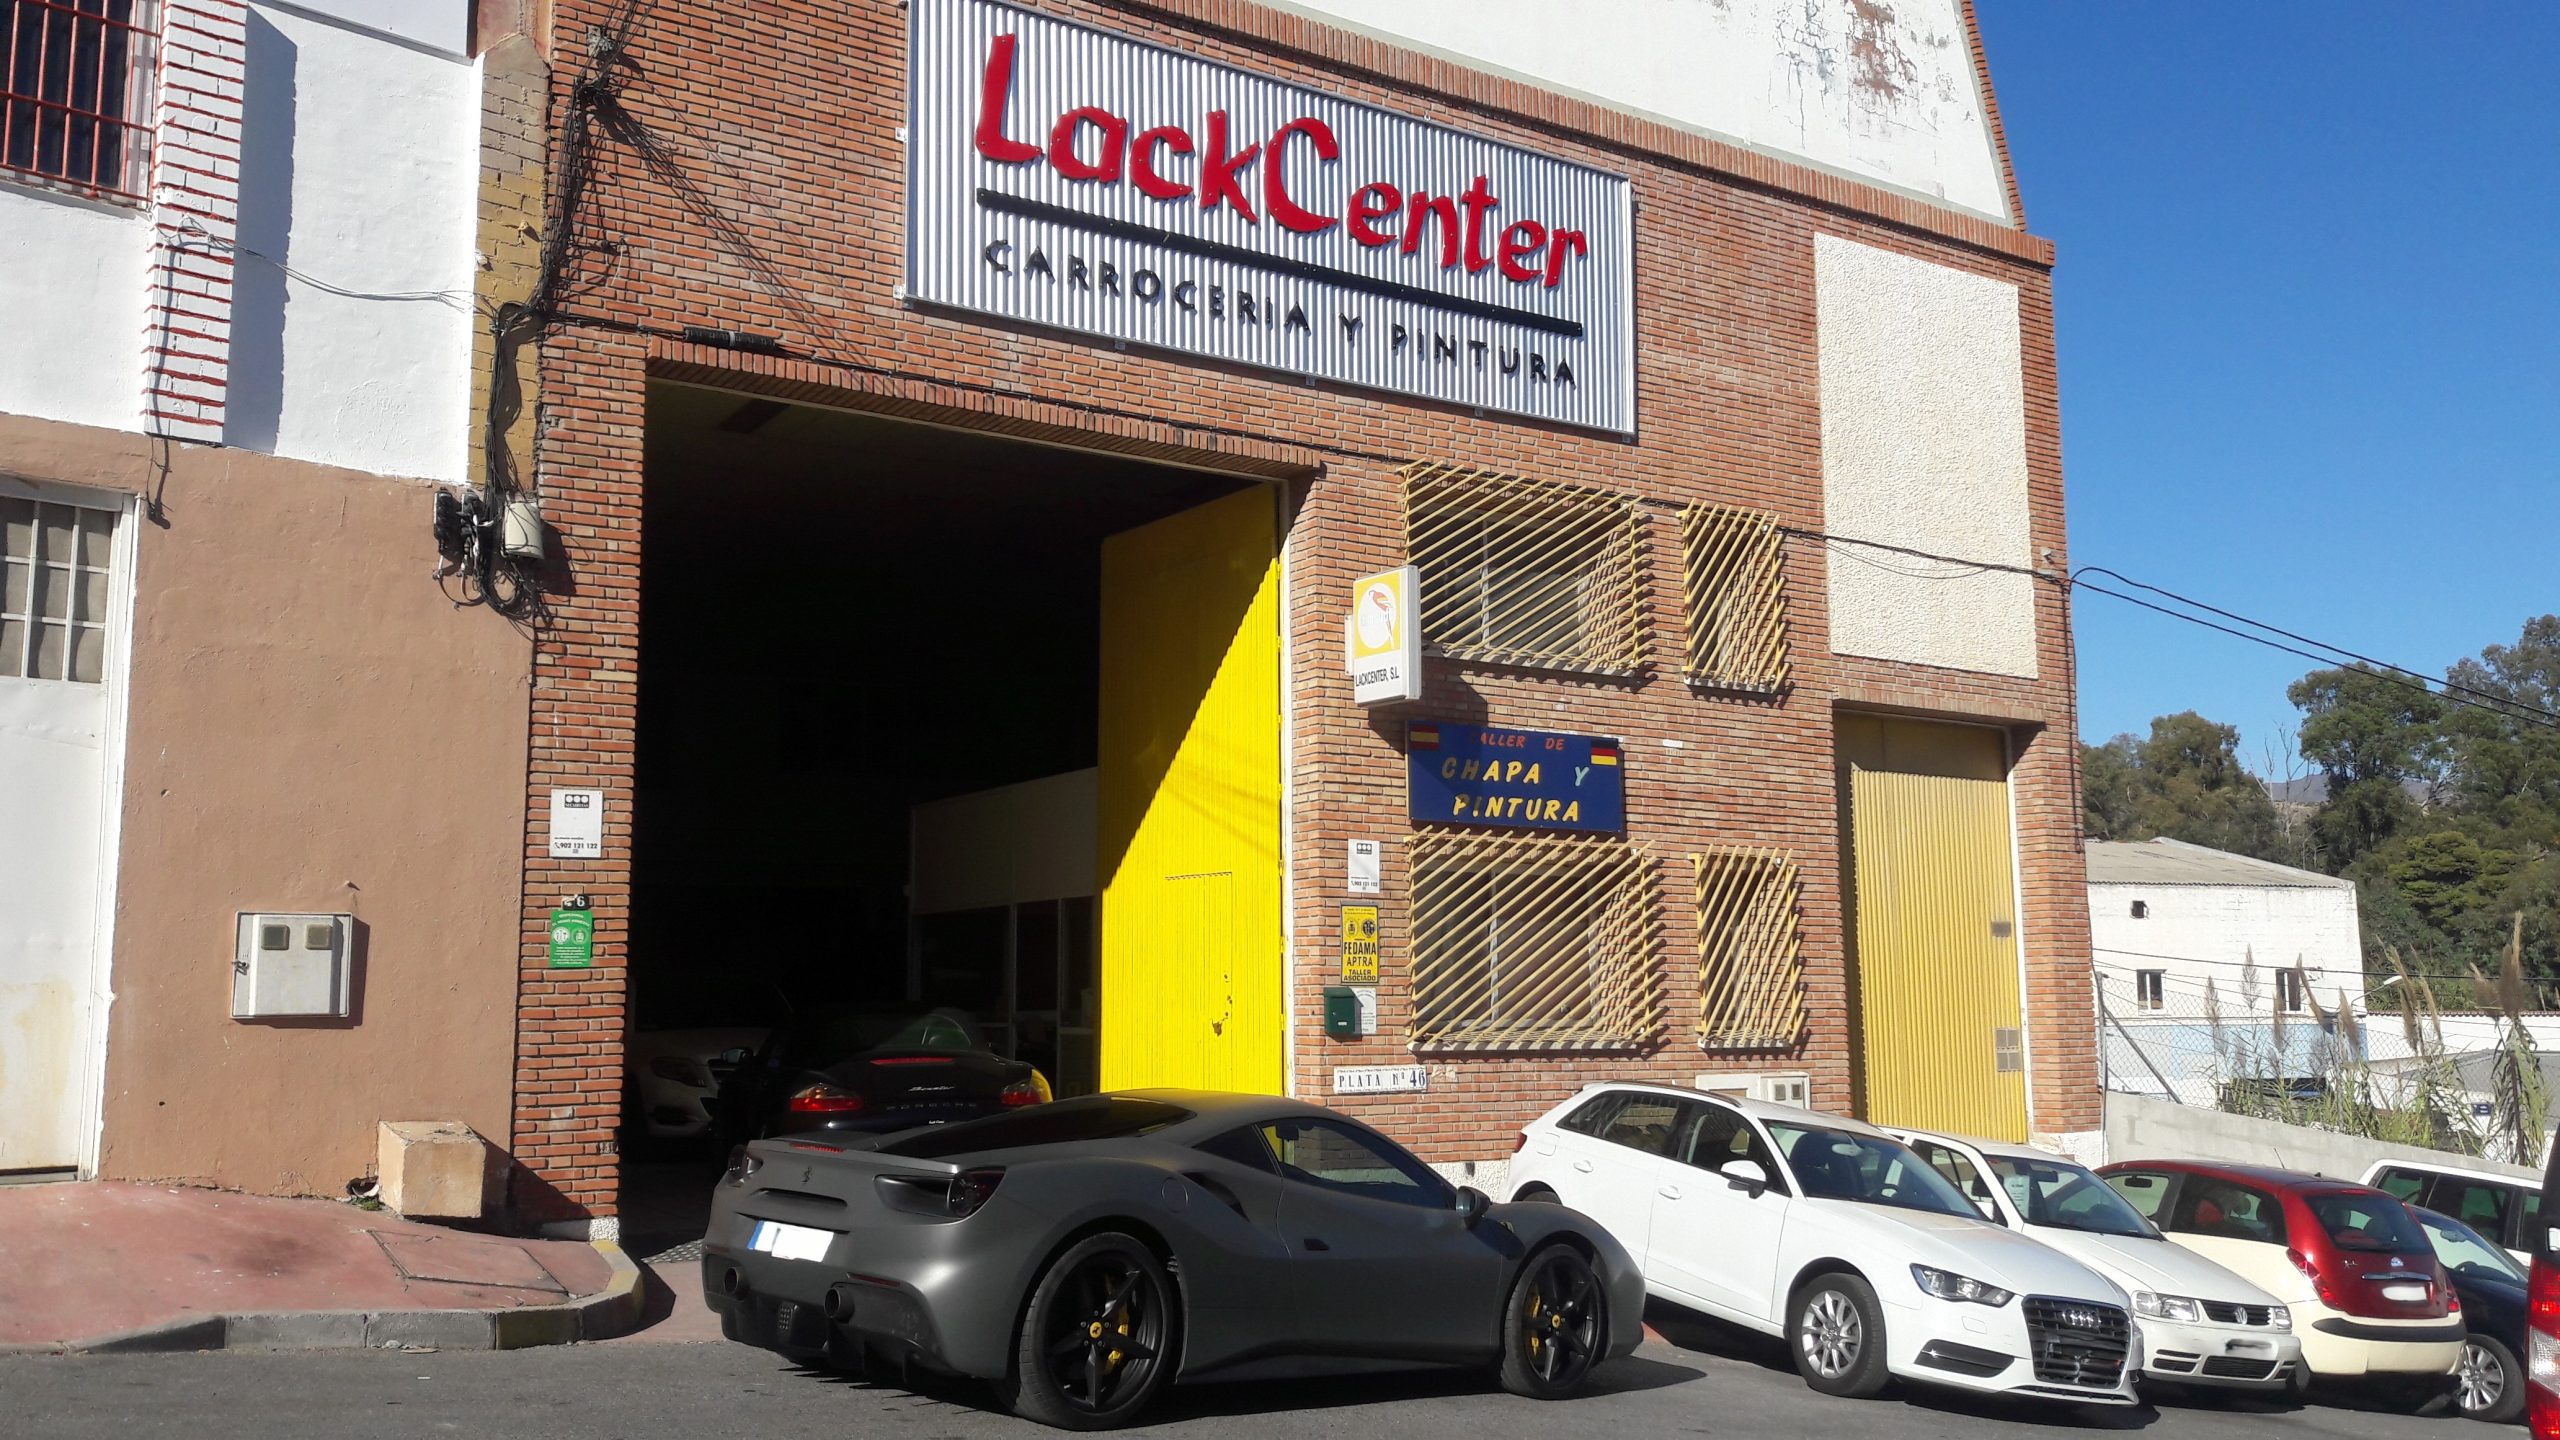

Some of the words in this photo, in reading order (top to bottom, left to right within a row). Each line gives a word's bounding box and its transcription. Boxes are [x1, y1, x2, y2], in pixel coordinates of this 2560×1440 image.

[976, 32, 1588, 288] LackCenter
[985, 238, 1312, 335] CARROCERIA
[1338, 311, 1363, 342] Y
[1391, 322, 1577, 388] PINTURA
[1472, 731, 1526, 749] ALLER
[1545, 737, 1565, 750] DE
[1441, 756, 1541, 785] CHAPA
[1574, 766, 1590, 787] Y
[1452, 793, 1579, 823] PINTURA
[1343, 941, 1376, 955] FEDAMA
[1346, 956, 1373, 967] APTRA
[1338, 1073, 1381, 1088] PLATA
[1409, 1069, 1426, 1087] 46
